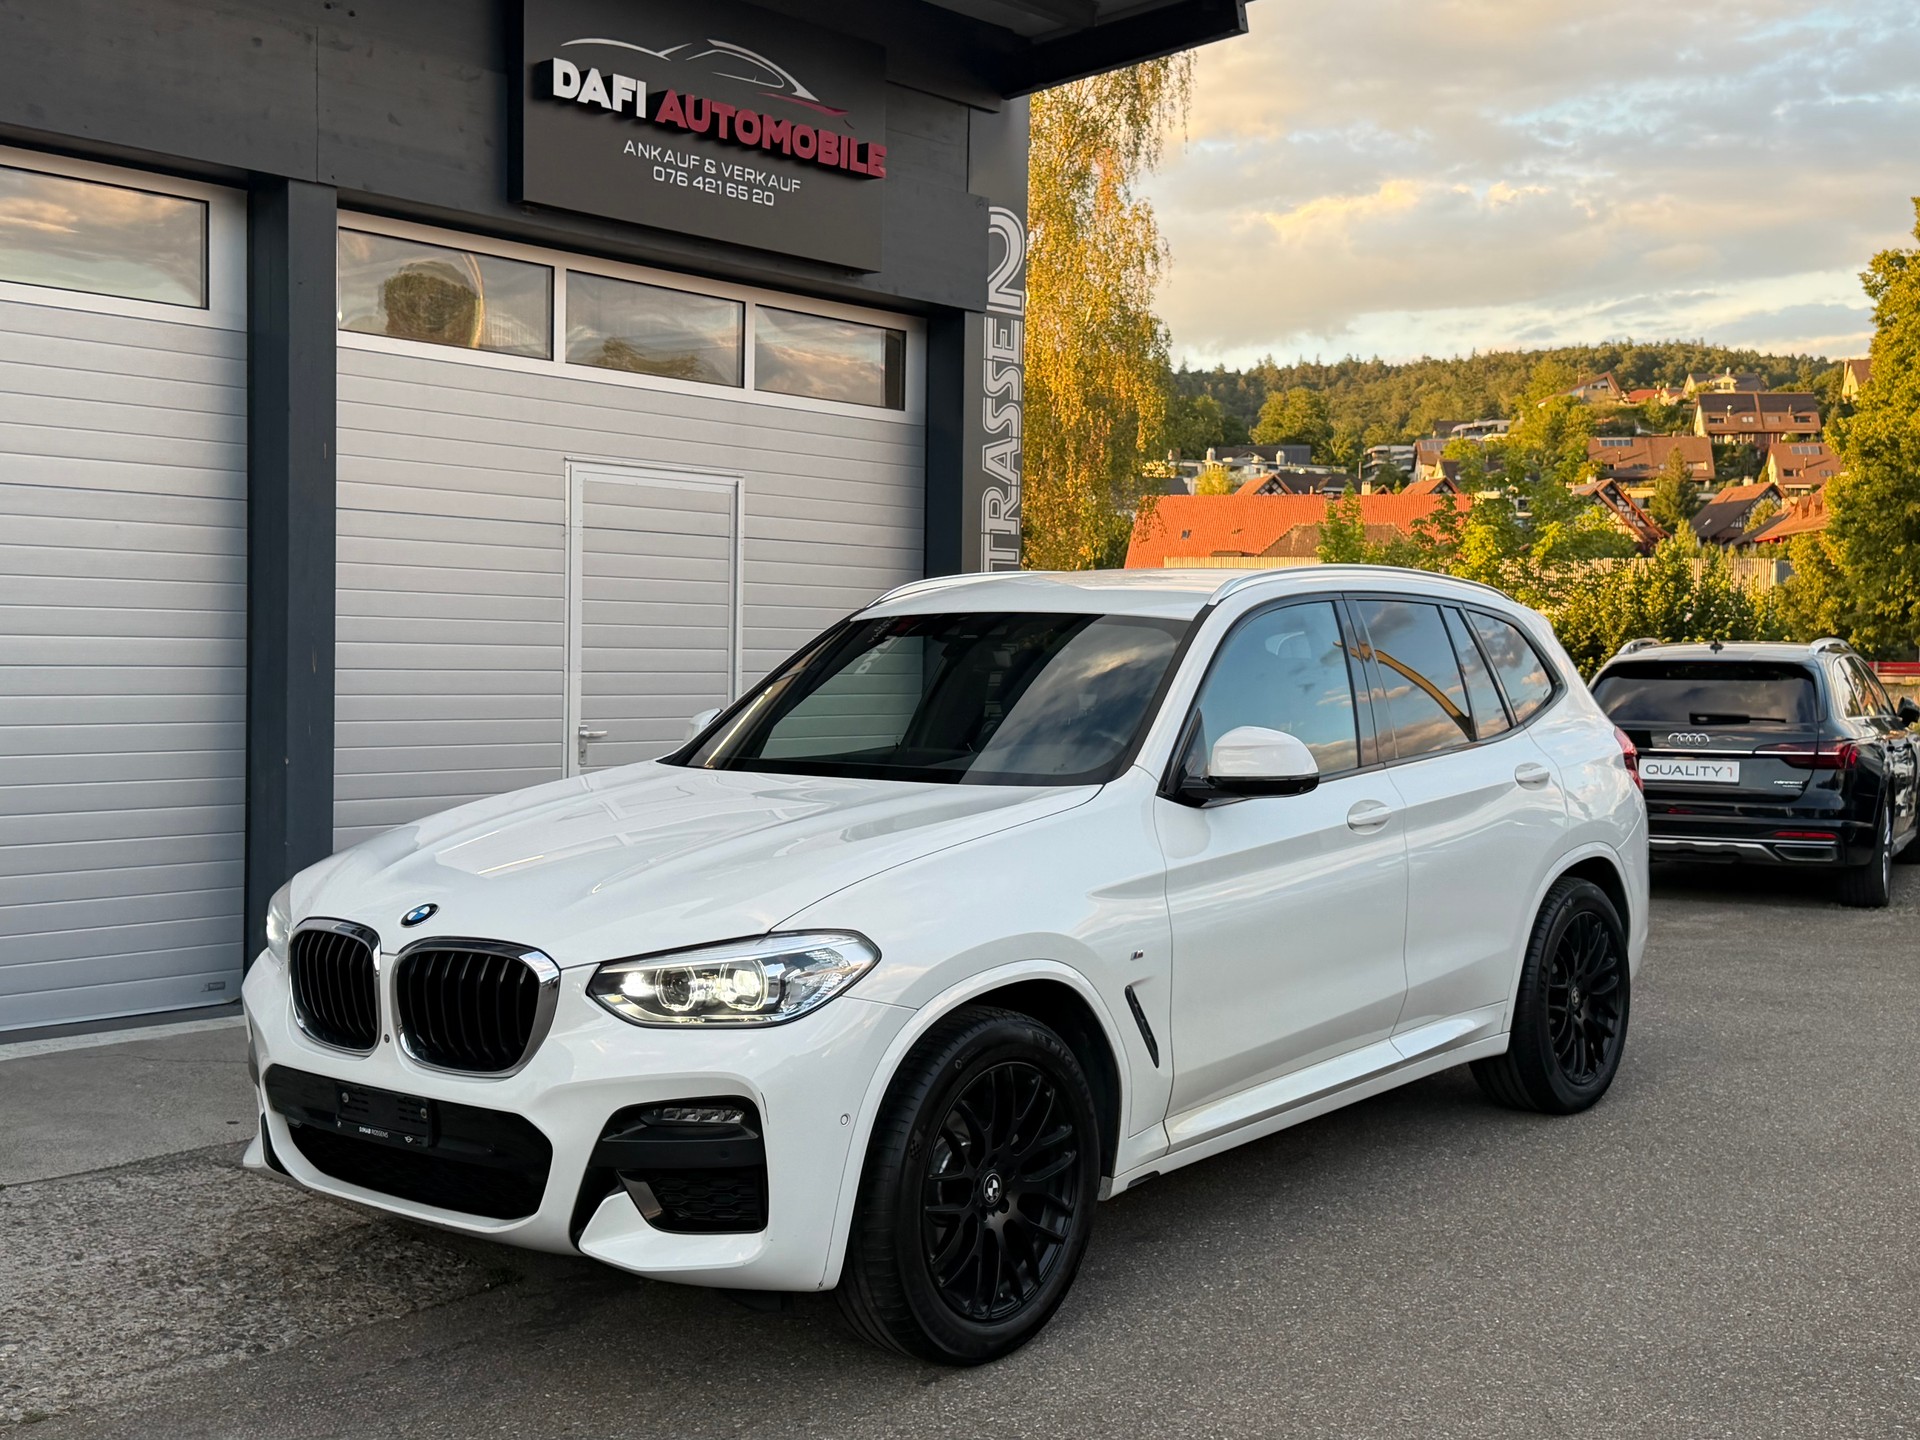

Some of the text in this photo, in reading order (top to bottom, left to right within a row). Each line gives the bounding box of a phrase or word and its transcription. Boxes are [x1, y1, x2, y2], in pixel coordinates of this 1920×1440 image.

[552, 57, 887, 179] DAFI AUTOMOBILE
[623, 140, 802, 193] ANKAUF & VERKAUF
[653, 165, 775, 207] 076 421 65 20
[980, 316, 1024, 574] TRASSE
[1645, 764, 1723, 777] QUALITY
